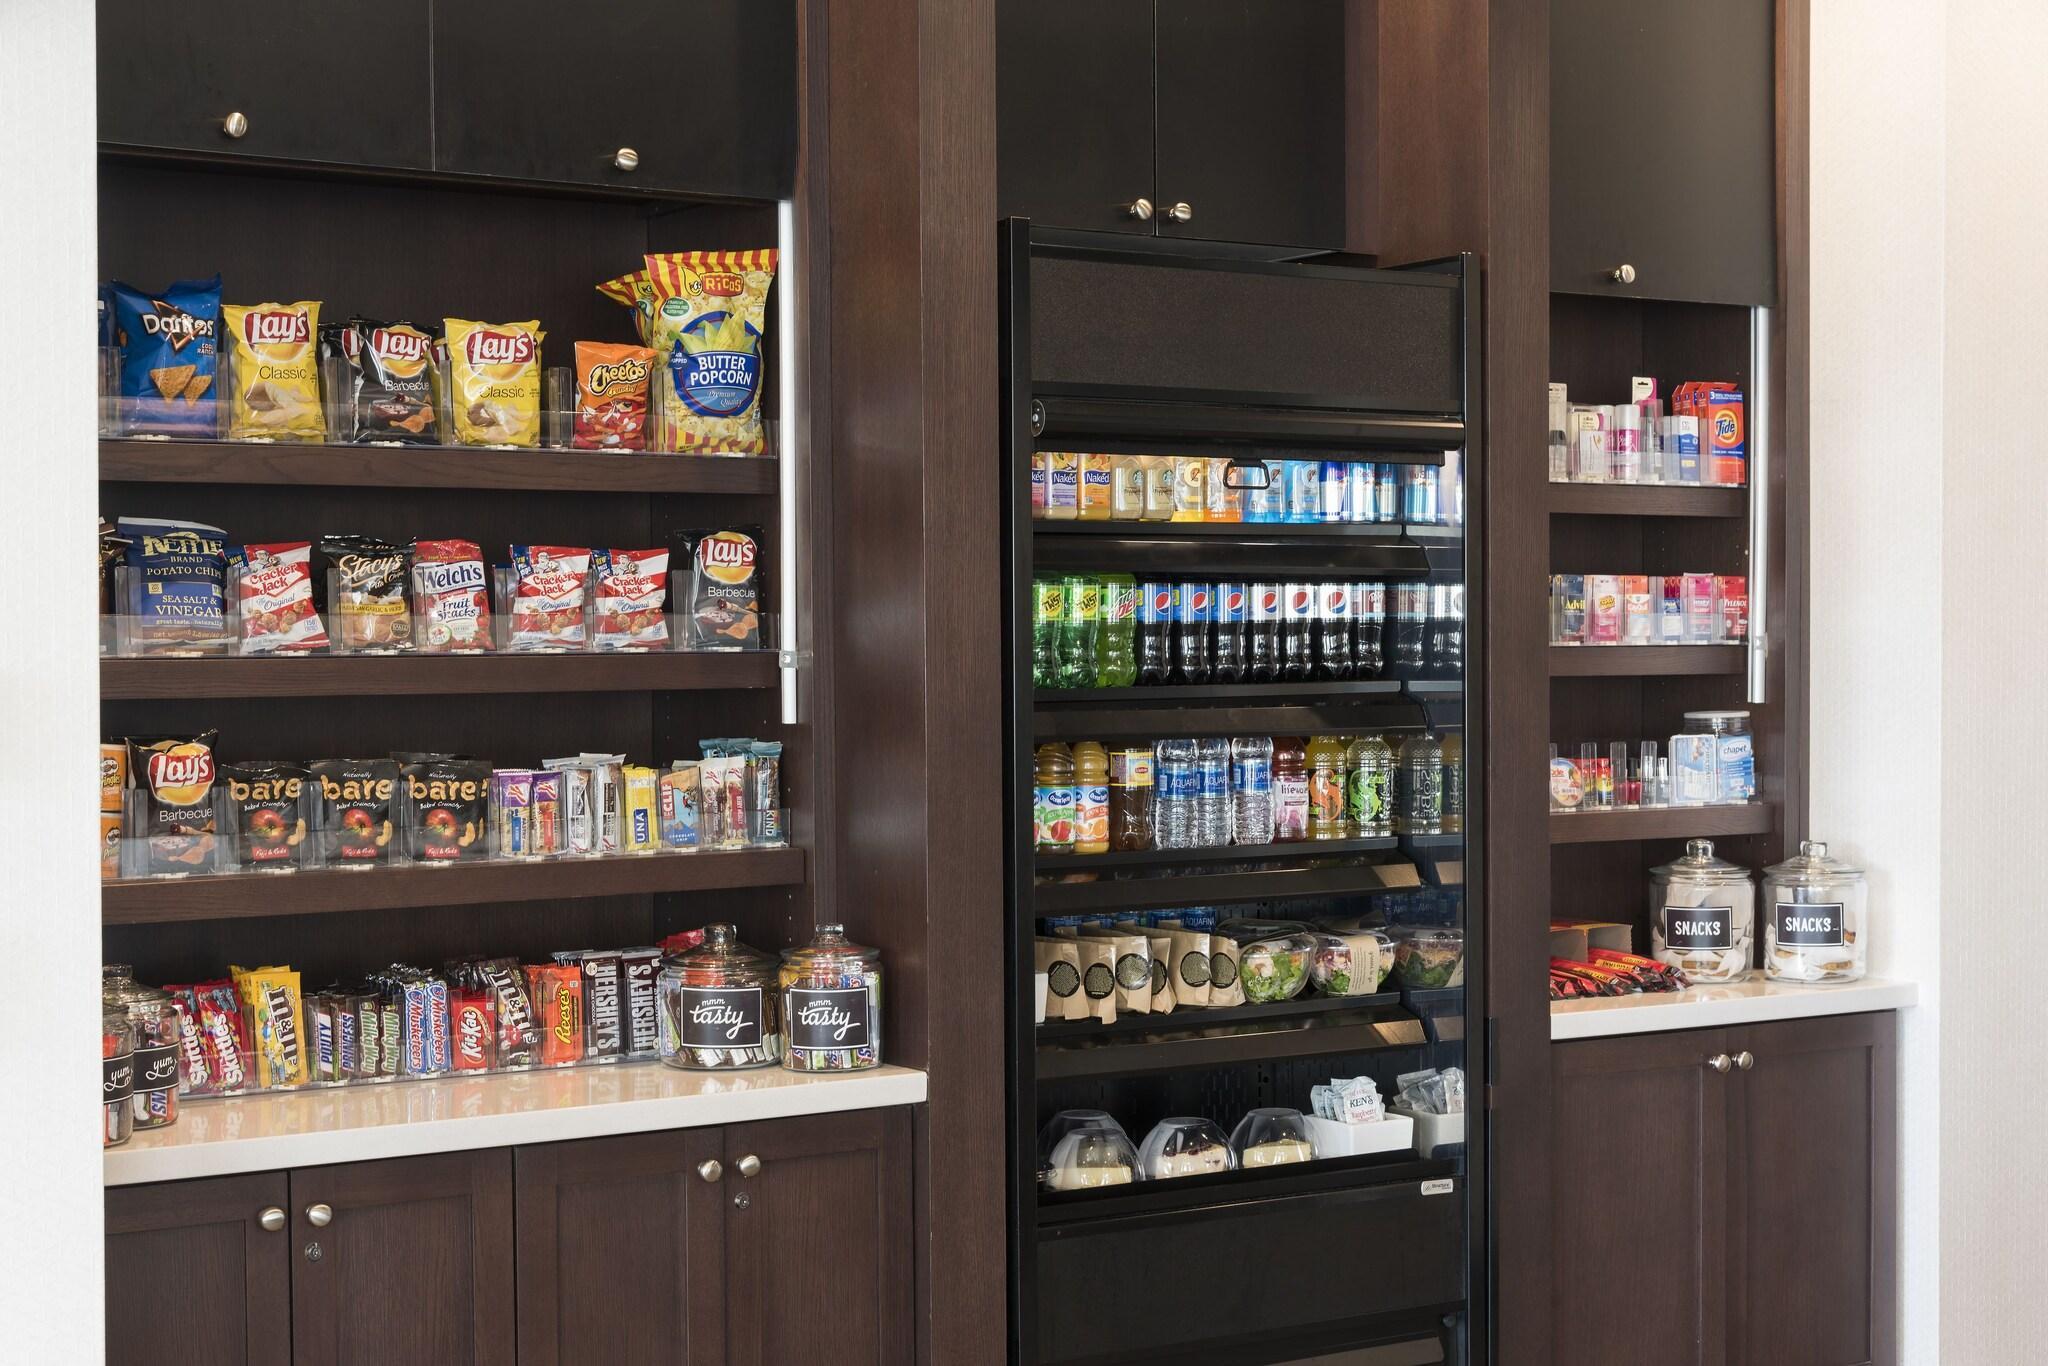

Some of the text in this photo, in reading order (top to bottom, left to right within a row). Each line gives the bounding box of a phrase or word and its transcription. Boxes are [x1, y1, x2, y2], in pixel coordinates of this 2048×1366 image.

[142, 313, 215, 337] Doritos
[251, 311, 309, 344] Lay's
[376, 329, 432, 361] Lay's
[471, 331, 531, 364] Lay's
[258, 366, 308, 380] Classic
[698, 355, 746, 371] BUTTER
[385, 379, 430, 392] Barbecue
[589, 360, 648, 393] Cheetos
[690, 370, 753, 386] POPCORN
[479, 386, 525, 399] Classic
[1715, 420, 1736, 437] Tide
[143, 531, 225, 557] KETTLE
[707, 539, 755, 567] Lay's
[170, 555, 203, 563] BRAND
[339, 554, 404, 583] Stacy's
[146, 566, 192, 576] POTATO
[250, 562, 298, 585] Cracker
[425, 564, 483, 588] Welch's
[532, 571, 576, 586] Cracker
[259, 576, 288, 596] Jack
[540, 584, 566, 597] Jack
[621, 585, 645, 598] Jack
[707, 586, 756, 599] Barbecue
[162, 595, 218, 605] SEA SALT &
[263, 594, 296, 610] Original
[443, 598, 470, 611] Fruit
[541, 598, 572, 611] Original
[621, 600, 650, 613] Original
[155, 605, 223, 619] VINEGAR
[156, 752, 210, 788] Lay's
[229, 776, 303, 801] bare
[321, 774, 393, 801] bare
[408, 774, 476, 801] bare
[662, 783, 673, 812] CLIF
[159, 807, 214, 823] Barbecue
[765, 810, 775, 837] KIND
[1675, 920, 1721, 937] SNACKS
[1785, 917, 1832, 933] SNACKS
[595, 964, 620, 1050] HERSHEY'S
[629, 963, 653, 1050] HERSHEY'S
[701, 998, 726, 1007] mmm
[808, 999, 832, 1008] mmm
[554, 987, 571, 1045] Reese's
[689, 1005, 754, 1040] tasty
[798, 1006, 861, 1041] tasty
[341, 1013, 355, 1072] PRINCESS
[409, 1002, 424, 1070] Musketeers
[430, 997, 446, 1066] Musketeers
[182, 1013, 209, 1086] Skittles
[214, 1012, 244, 1085] Skittles
[319, 1021, 333, 1066] POUTY
[1350, 1095, 1374, 1108] KEN'S
